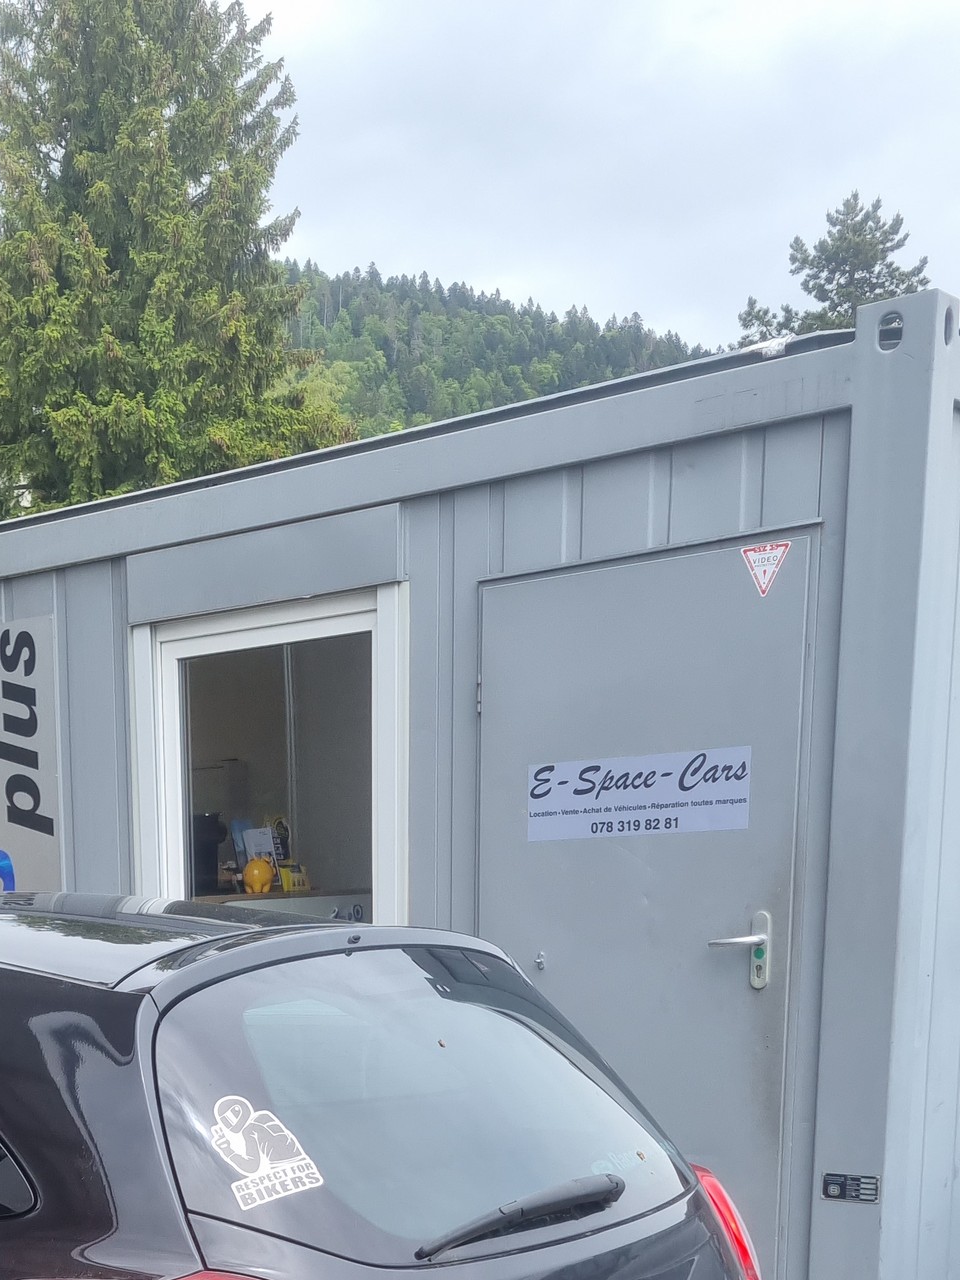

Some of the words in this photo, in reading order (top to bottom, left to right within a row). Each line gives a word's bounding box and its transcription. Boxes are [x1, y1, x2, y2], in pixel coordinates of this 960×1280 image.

[752, 555, 778, 565] VIDEO
[690, 799, 714, 807] toutes
[715, 797, 748, 806] marques
[590, 821, 614, 834] 078
[617, 819, 641, 832] 319
[644, 818, 661, 831] 82
[664, 816, 679, 829] 81
[235, 1170, 288, 1194] RESPECT
[290, 1162, 314, 1176] FOR
[239, 1171, 321, 1208] BIKERS
